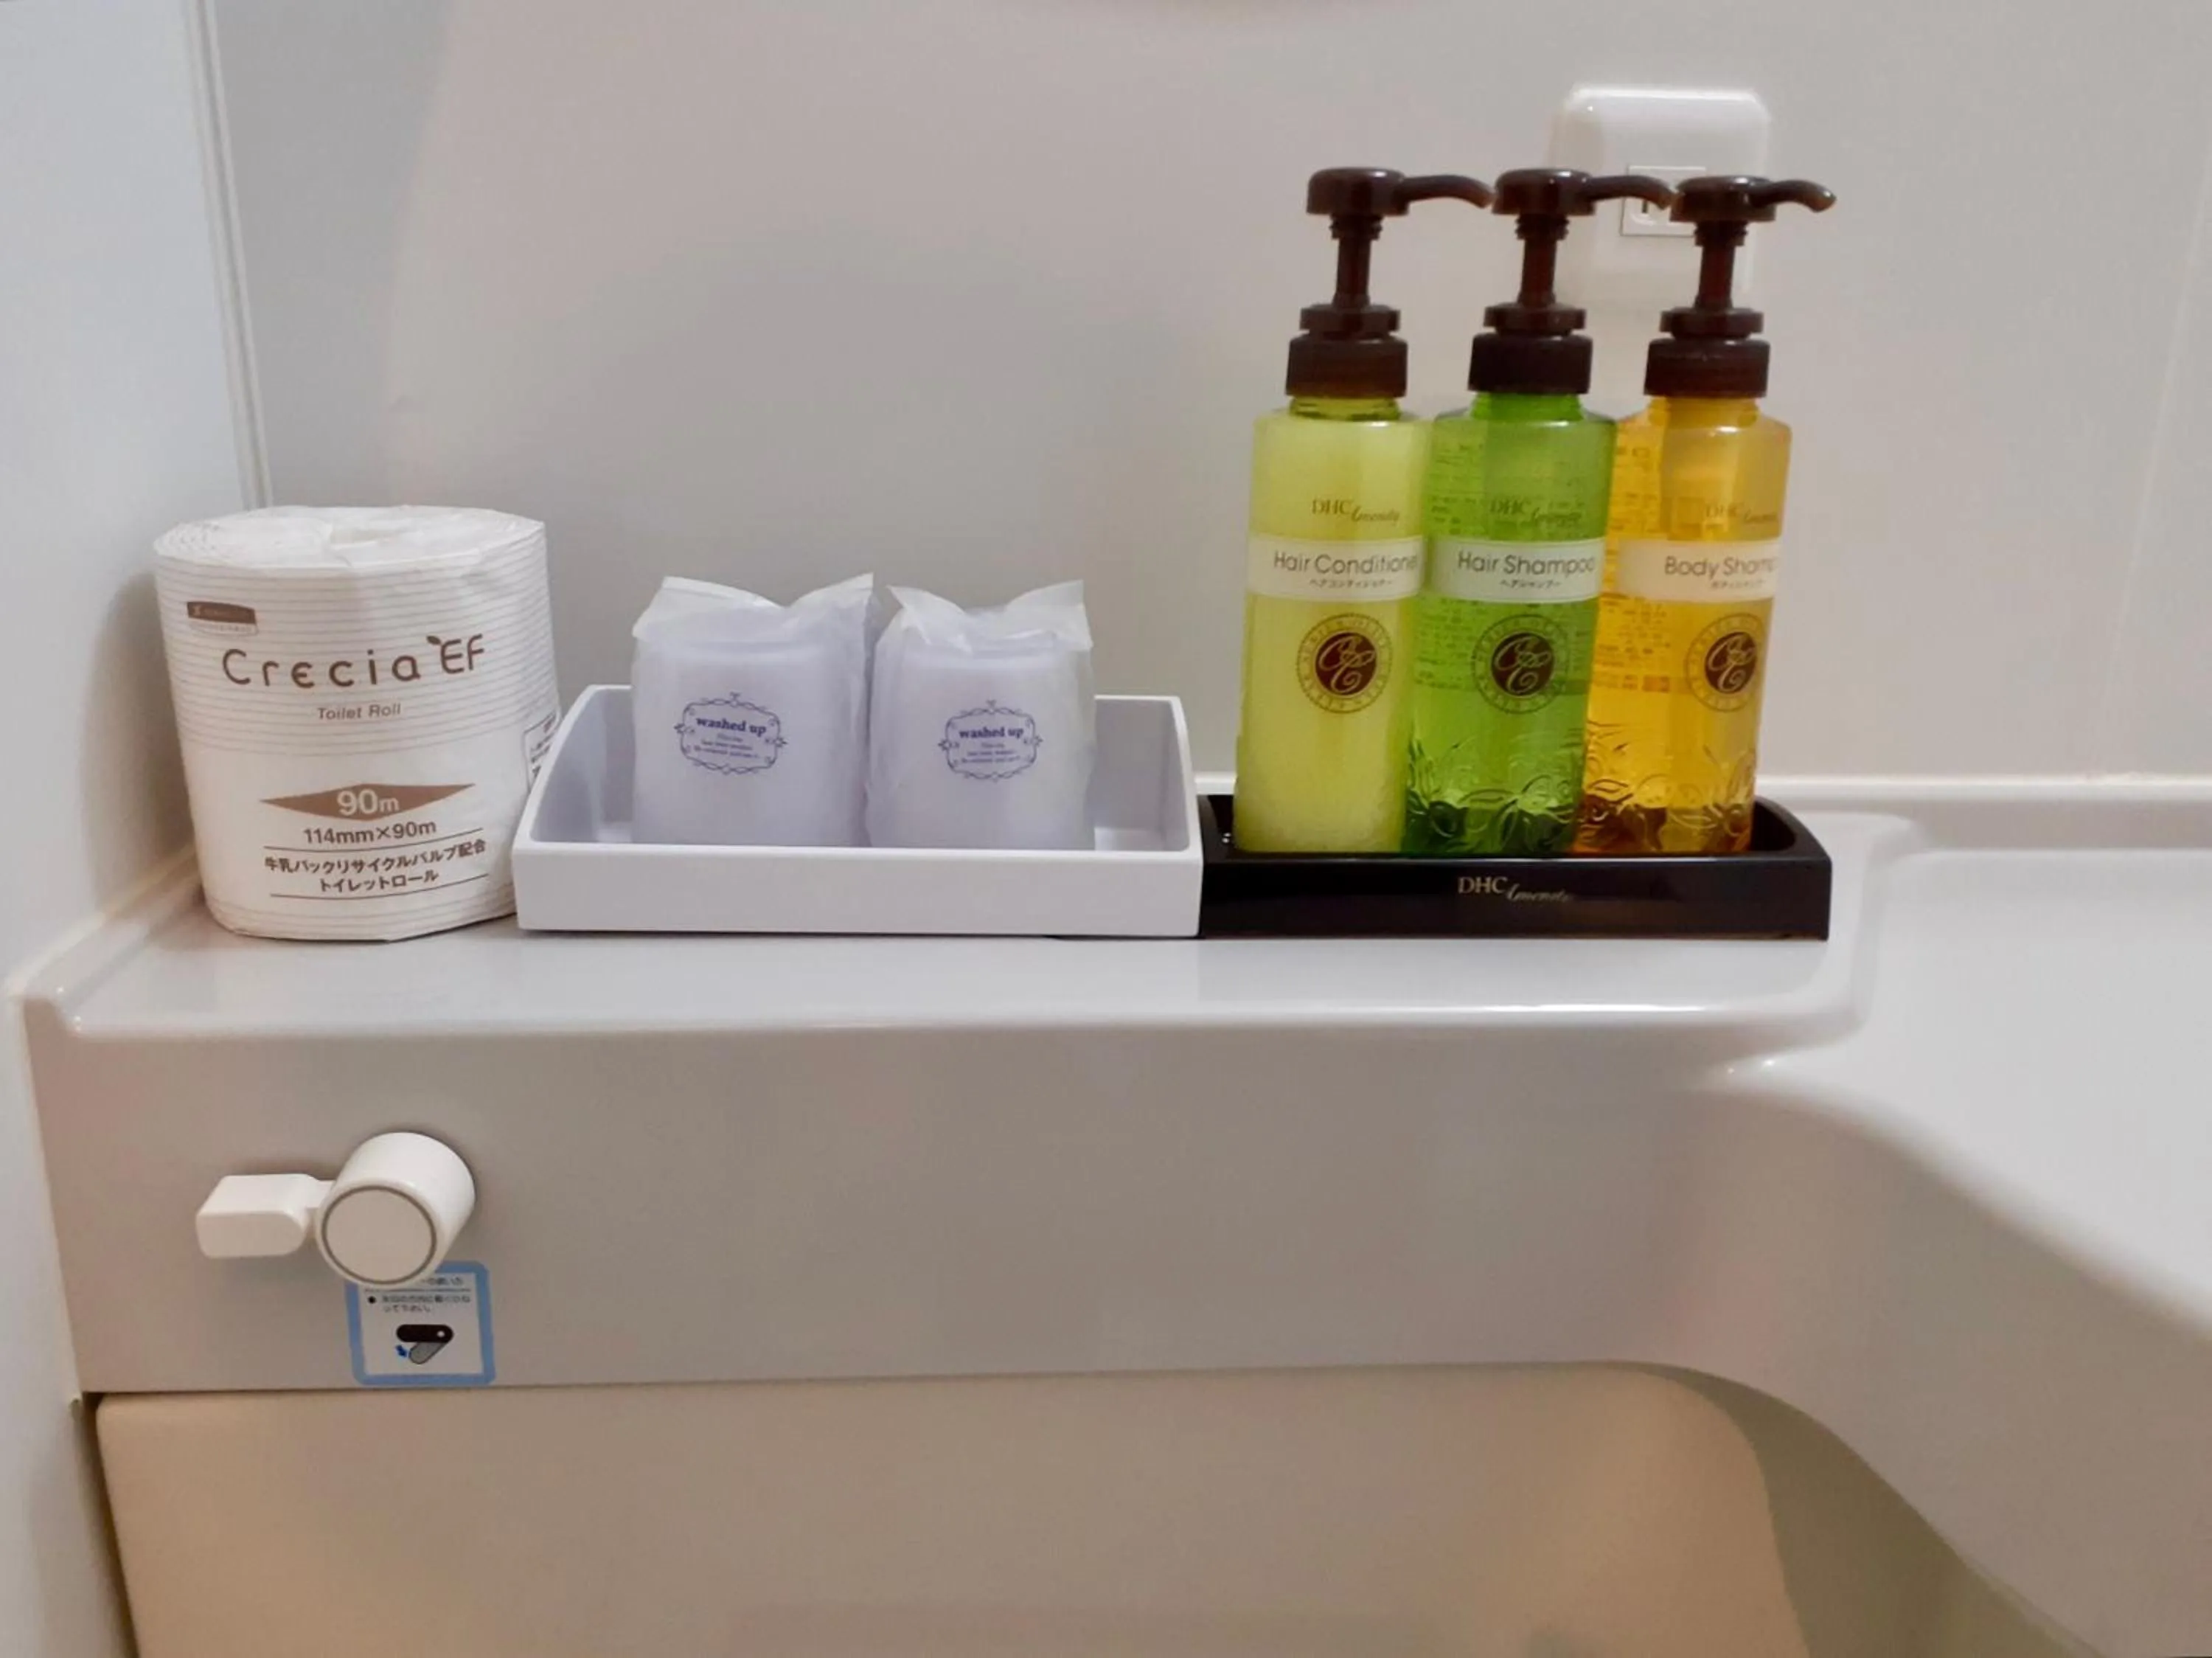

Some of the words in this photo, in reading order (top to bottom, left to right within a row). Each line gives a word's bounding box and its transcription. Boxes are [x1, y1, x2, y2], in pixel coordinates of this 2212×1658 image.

[1273, 550, 1310, 572] Hair
[1458, 551, 1498, 572] Hair
[1503, 555, 1595, 577] Shampoo
[1664, 555, 1719, 580] Body
[223, 648, 420, 687] Crecia
[317, 707, 362, 720] Toilet
[369, 703, 401, 718] Roll
[696, 718, 747, 732] washed
[748, 724, 767, 737] up
[959, 726, 1006, 739] washed
[1007, 728, 1024, 740] up
[336, 788, 400, 816] 90m
[319, 869, 439, 893] トイレットロール
[1457, 876, 1509, 895] DHC
